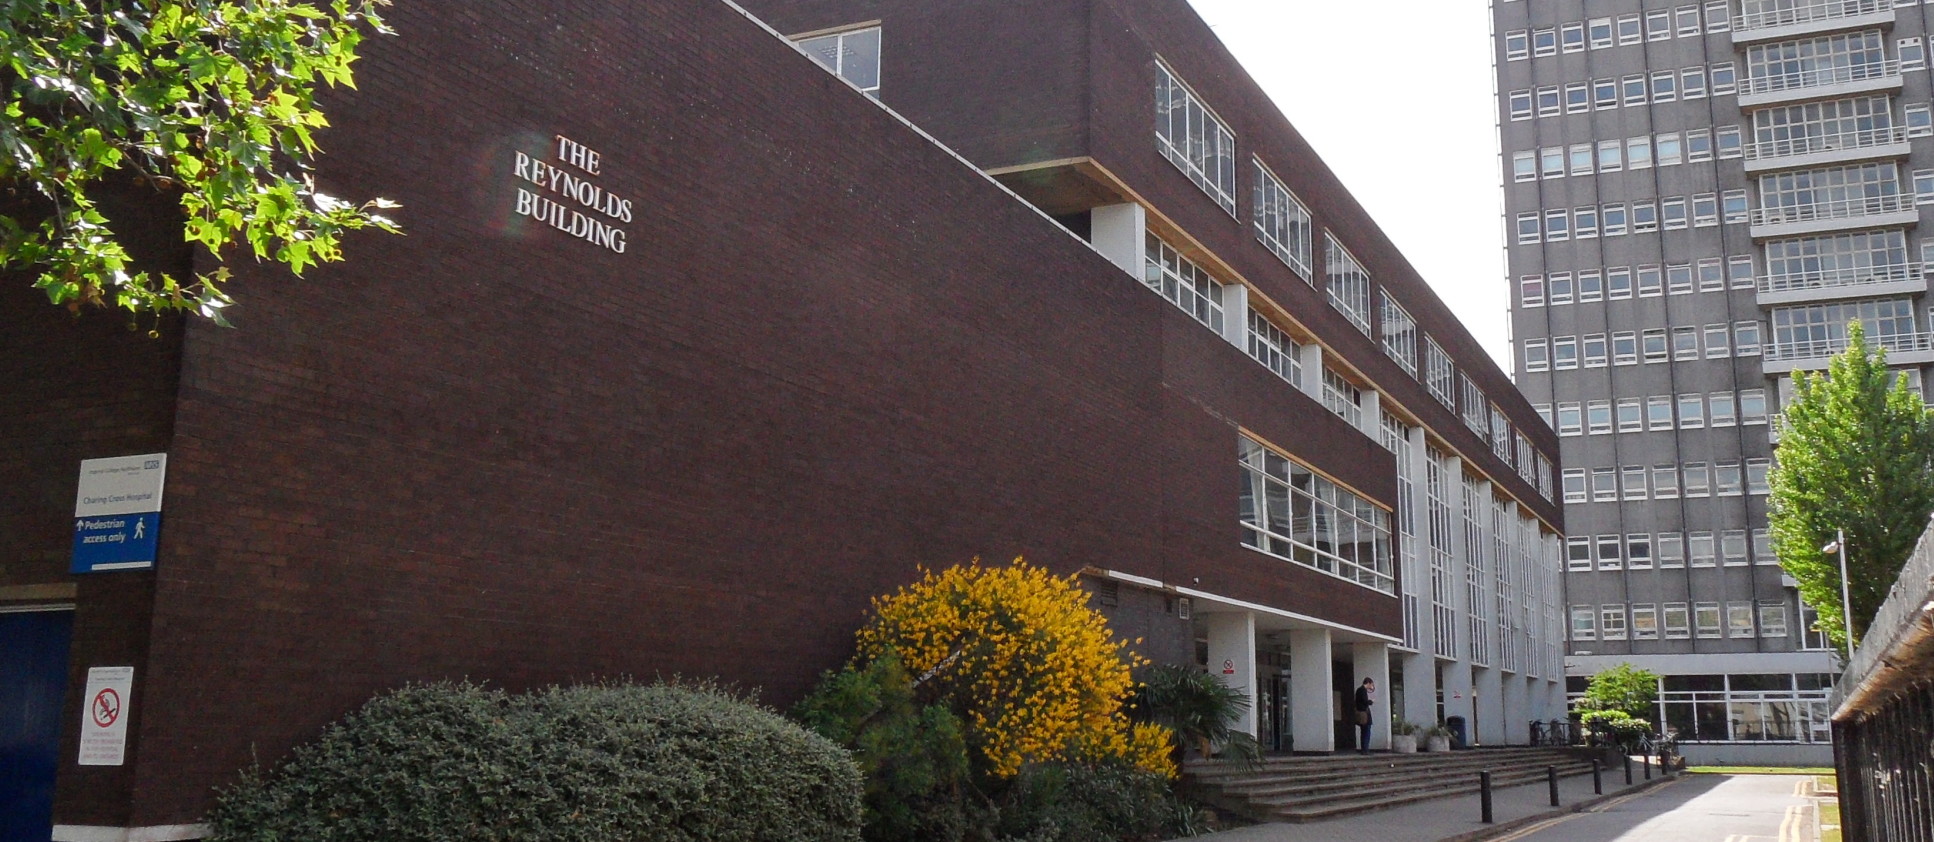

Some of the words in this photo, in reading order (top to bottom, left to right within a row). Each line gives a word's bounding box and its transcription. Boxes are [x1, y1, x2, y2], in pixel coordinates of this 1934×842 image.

[557, 134, 600, 176] THE
[514, 150, 632, 223] REYNOLDS
[515, 187, 626, 253] BUILDING
[127, 492, 152, 502] Hospital
[83, 534, 107, 543] access
[108, 532, 126, 543] only
[85, 518, 126, 530] Pedestrian
